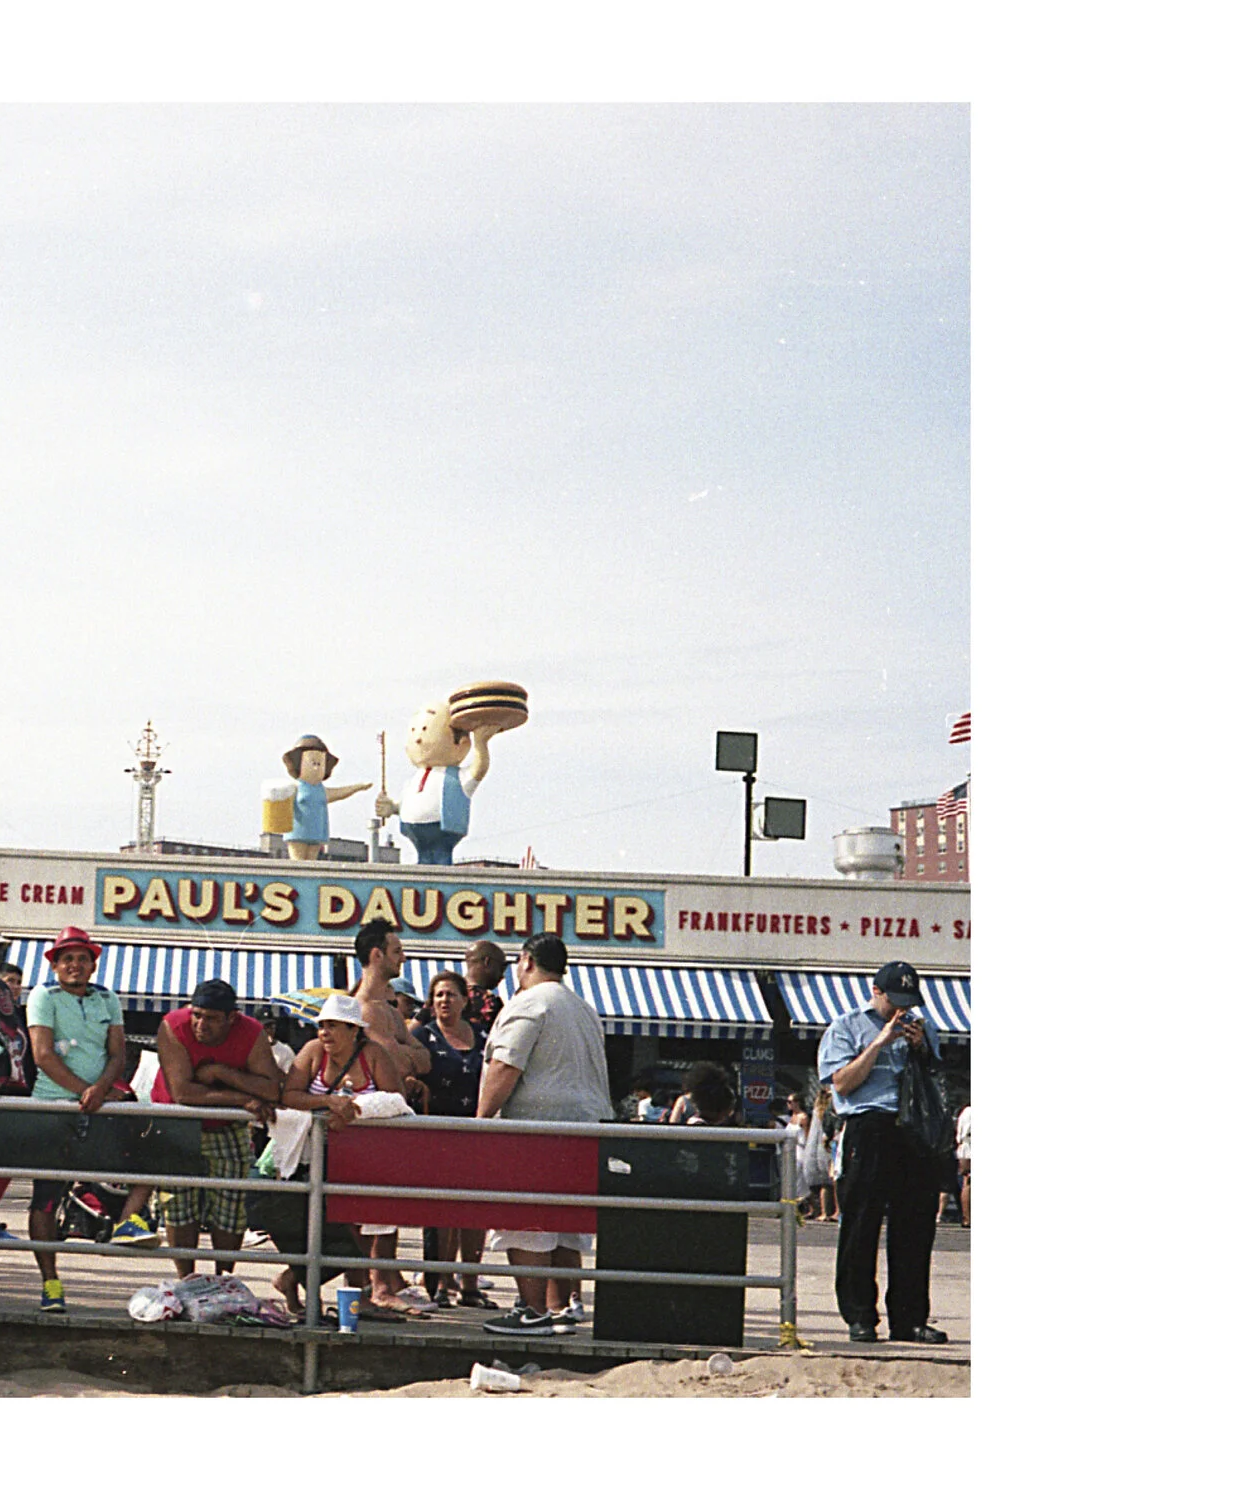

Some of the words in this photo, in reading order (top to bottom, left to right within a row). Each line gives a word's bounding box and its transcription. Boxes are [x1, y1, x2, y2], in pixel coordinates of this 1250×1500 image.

[21, 883, 86, 905] CREAM
[102, 875, 299, 928] PAUL'S
[318, 885, 655, 941] DAUGHTER
[679, 910, 832, 936] FRANKFURTERS
[861, 917, 920, 938] PIZZA
[744, 1085, 774, 1101] PIZZA
